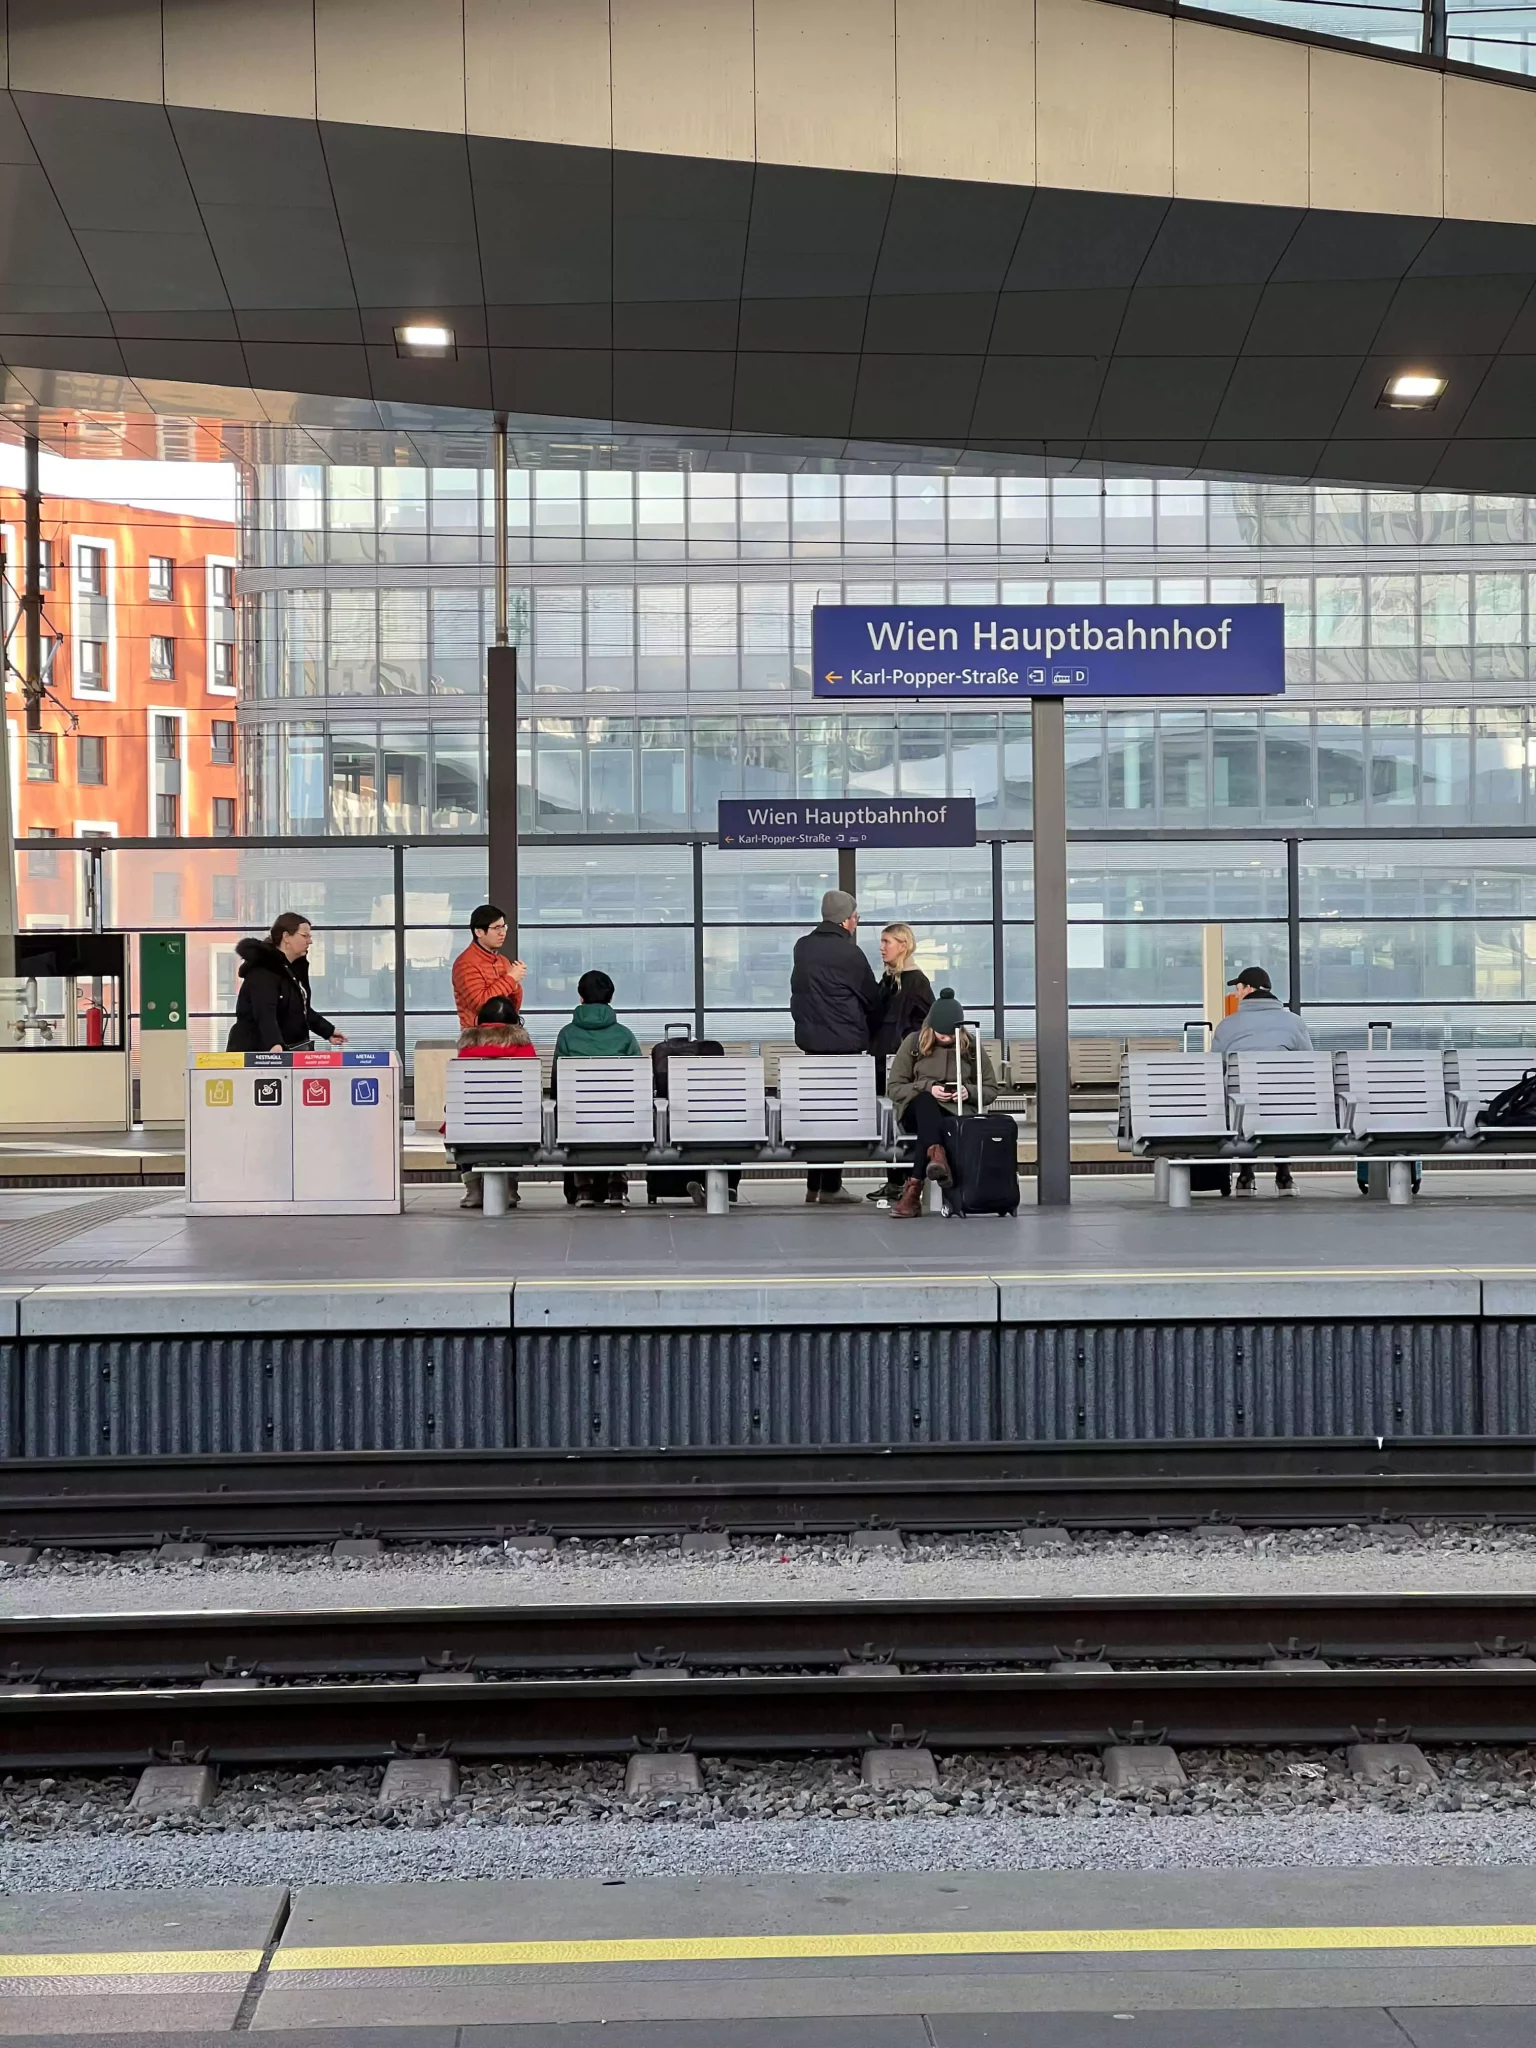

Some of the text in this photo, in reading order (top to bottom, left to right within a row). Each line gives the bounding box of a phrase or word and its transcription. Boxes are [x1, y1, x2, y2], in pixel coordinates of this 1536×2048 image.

[867, 618, 1233, 659] Wien Hauptbahnhof
[851, 668, 1085, 688] Karl-Popper-Straße D
[747, 806, 948, 829] Wien Hauptbahnhof
[738, 834, 831, 845] Karl-Popper-Straße
